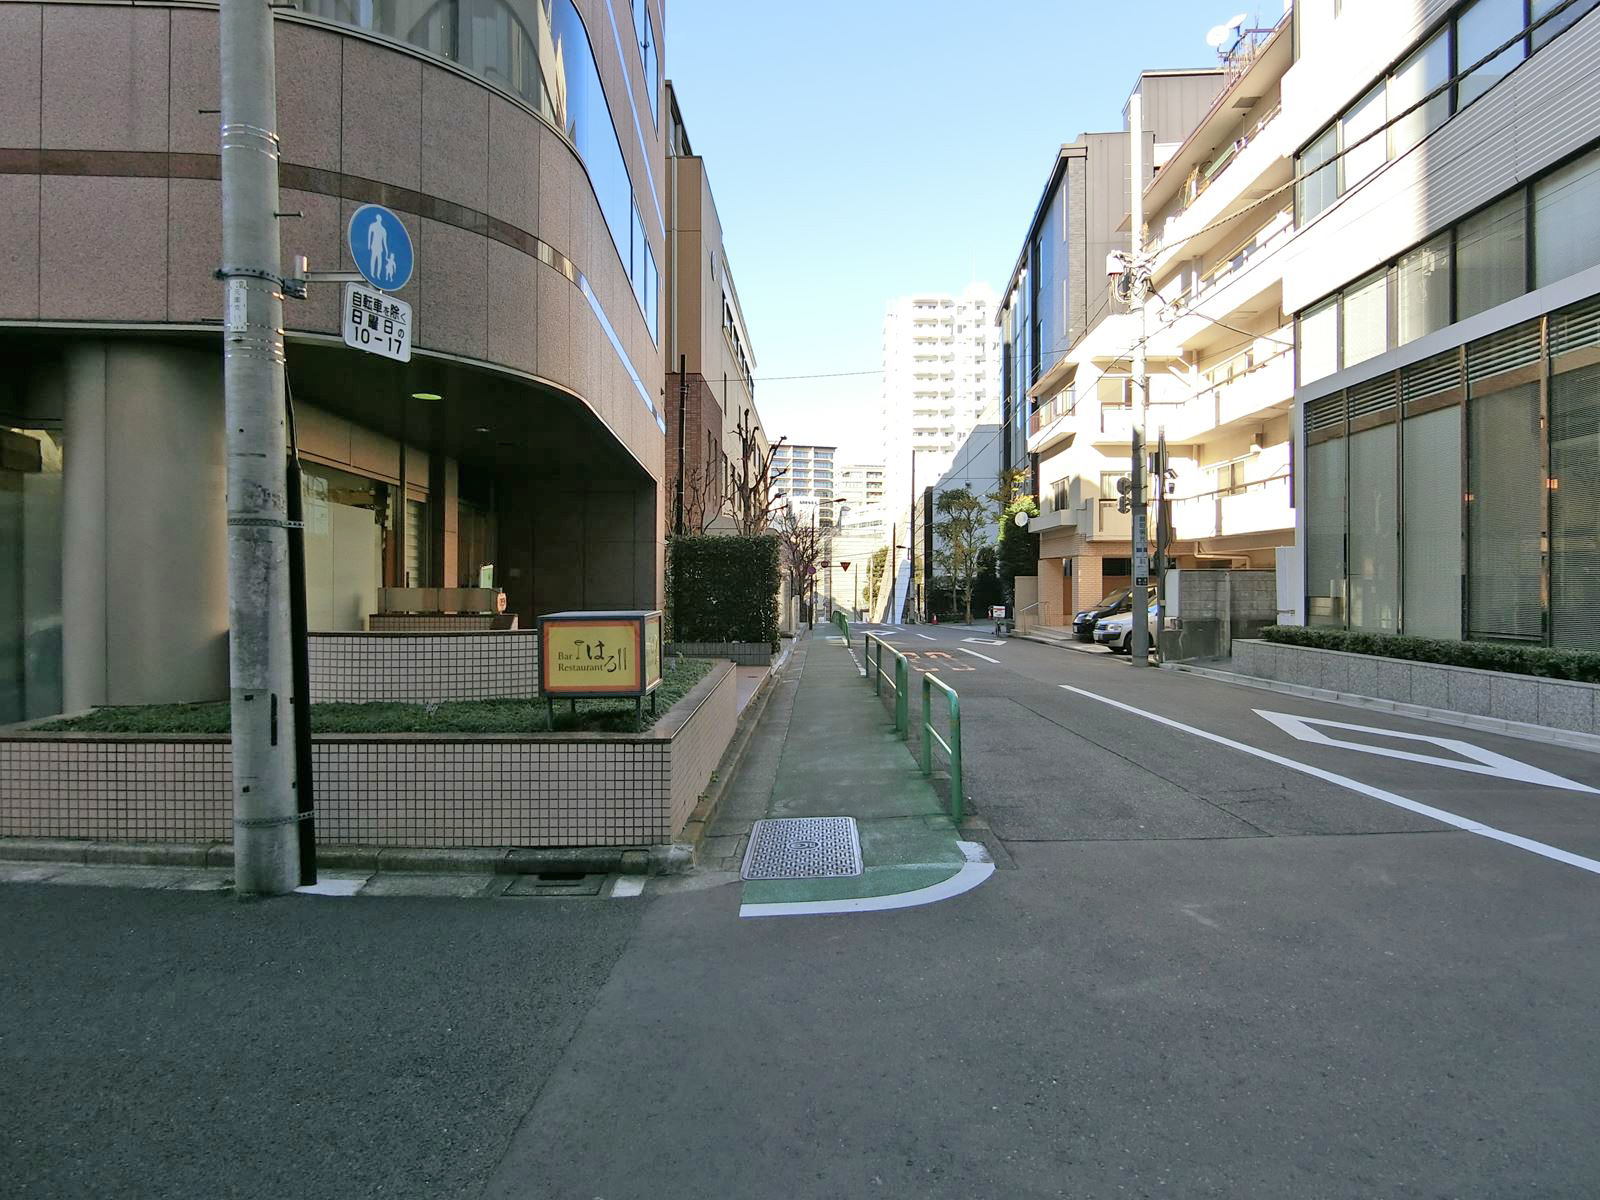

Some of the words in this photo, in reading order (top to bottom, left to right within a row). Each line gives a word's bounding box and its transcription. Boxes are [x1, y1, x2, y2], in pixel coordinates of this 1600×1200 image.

[353, 291, 406, 323] 自転車を除く
[352, 308, 405, 339] 日曜日の
[558, 651, 573, 661] Bar
[558, 663, 603, 672] Restaurant
